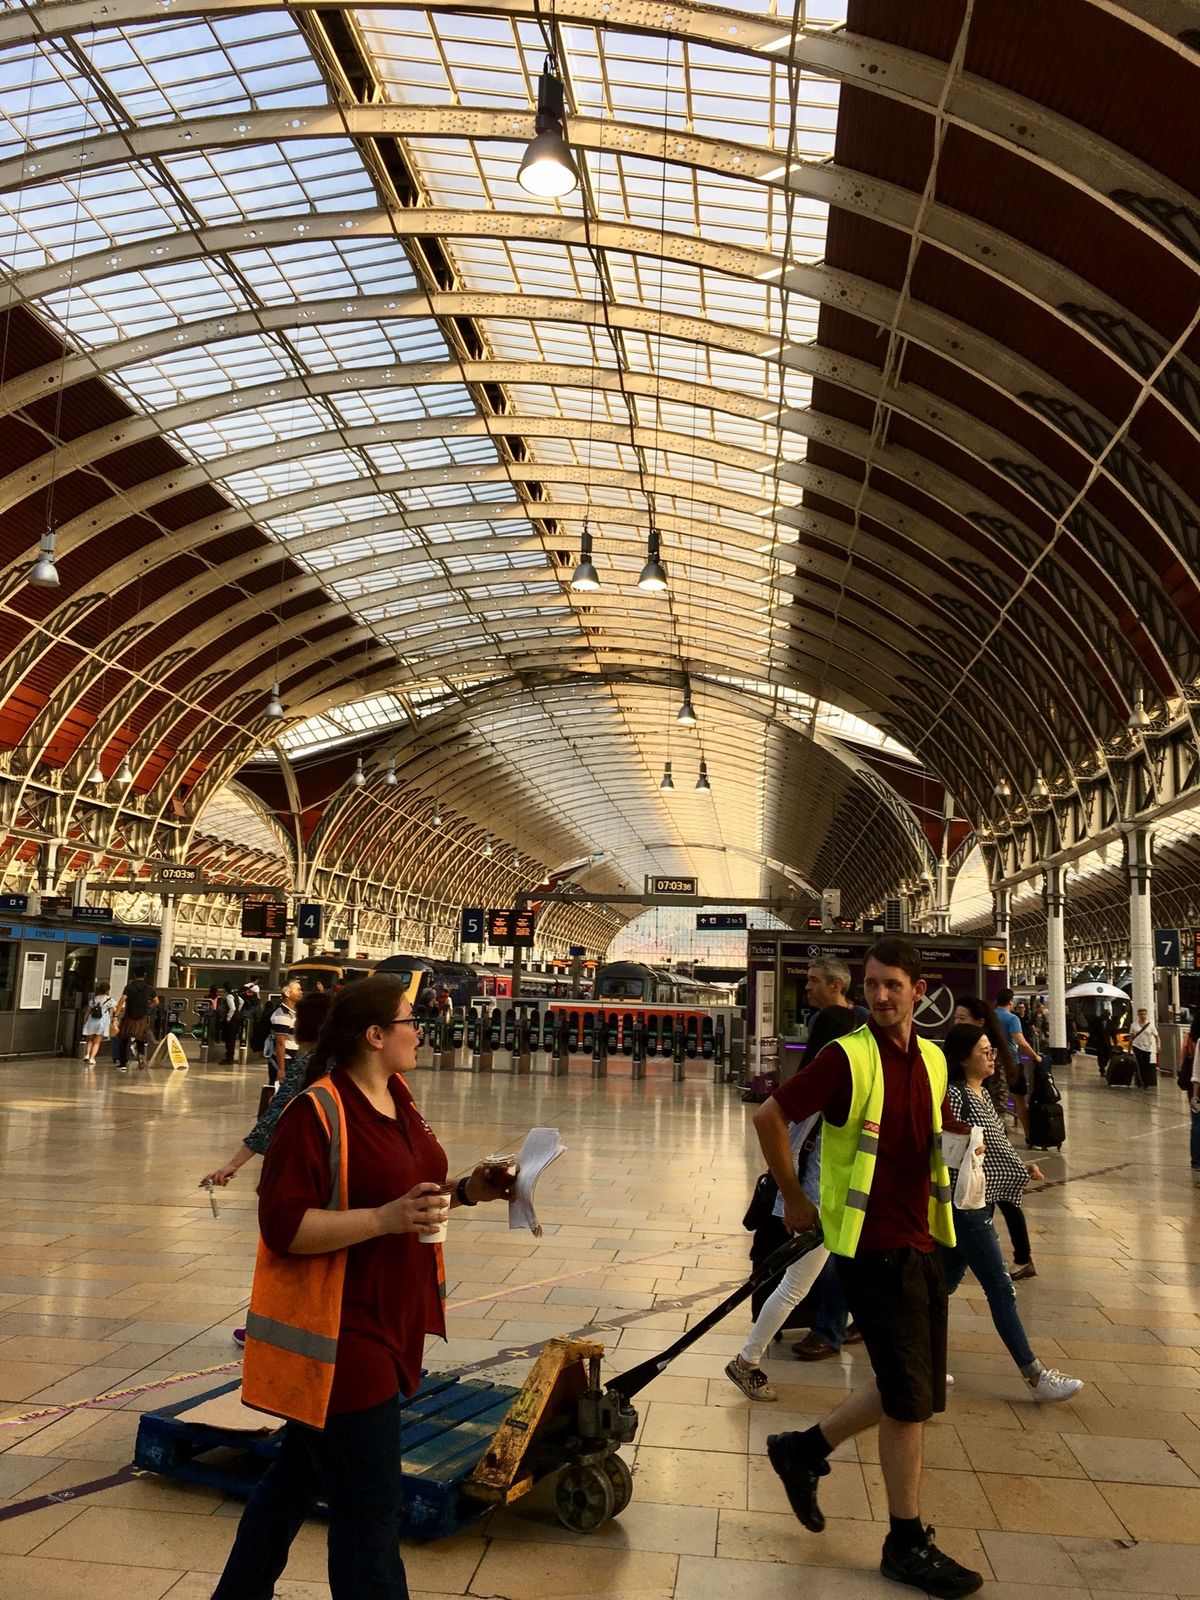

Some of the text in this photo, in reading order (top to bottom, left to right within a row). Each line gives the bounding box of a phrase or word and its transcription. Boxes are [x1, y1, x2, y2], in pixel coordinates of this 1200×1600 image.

[304, 914, 315, 928] 4
[467, 918, 478, 933] 5
[751, 946, 775, 954] Tickets
[821, 946, 850, 954] Heathrow
[1161, 940, 1173, 956] 7
